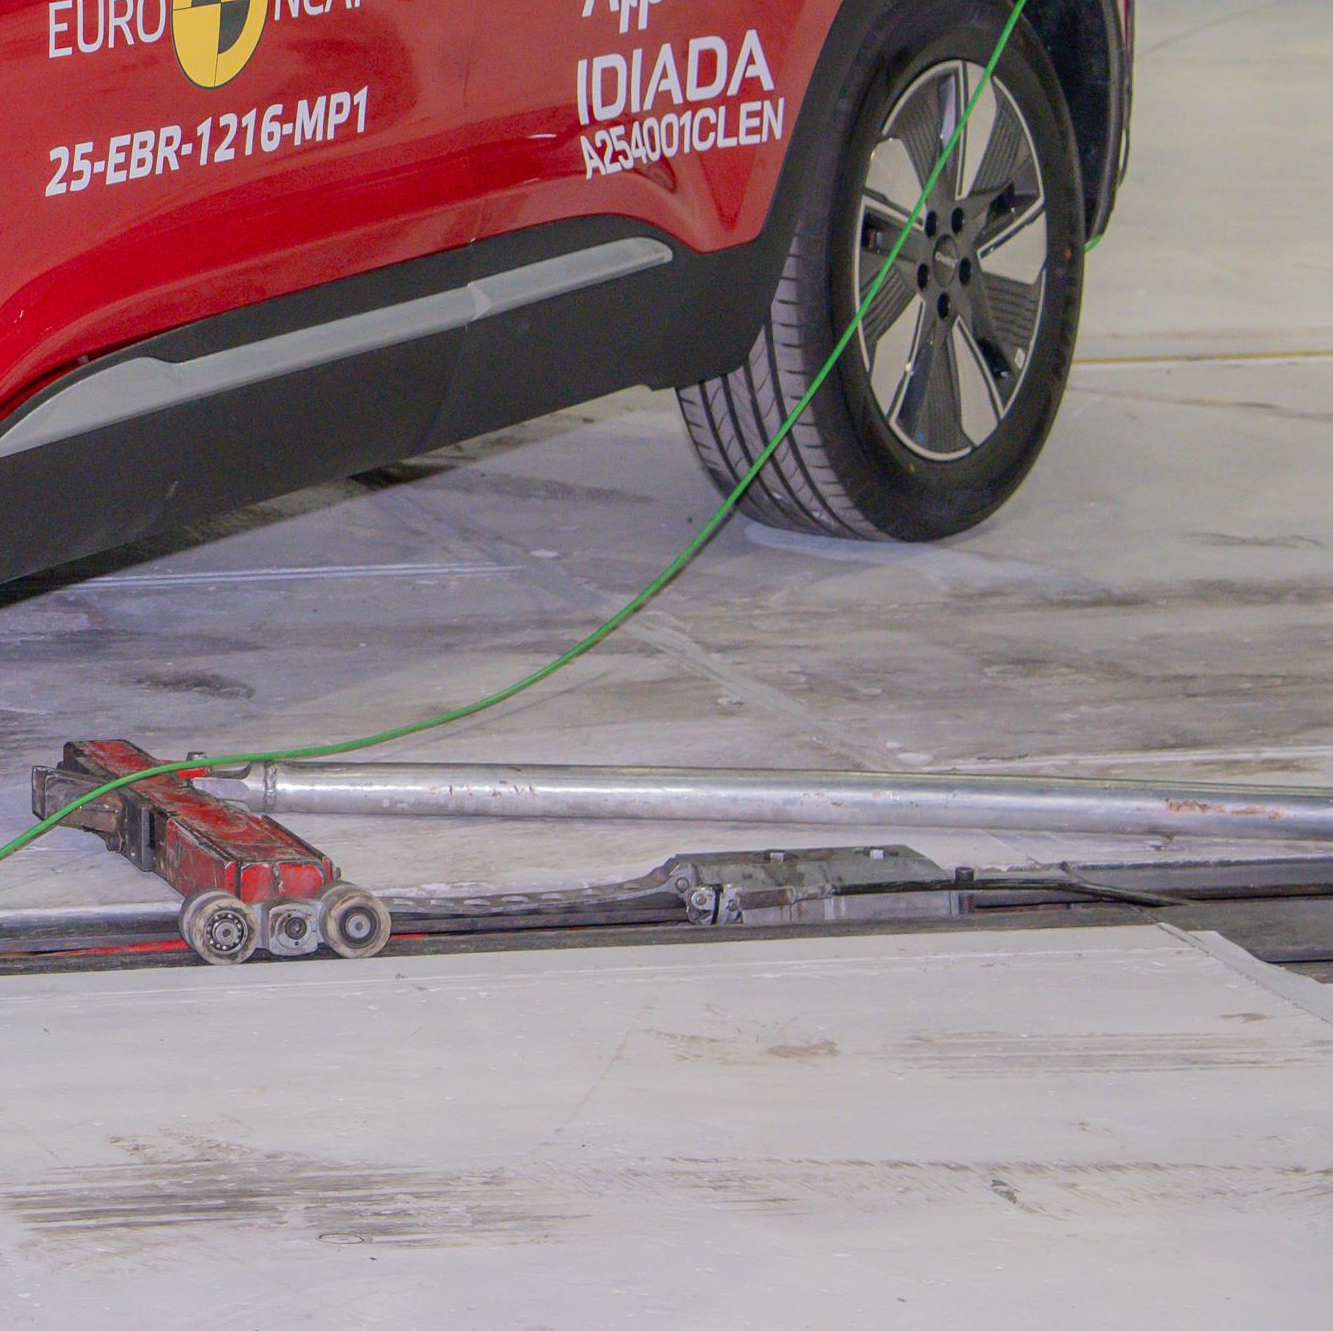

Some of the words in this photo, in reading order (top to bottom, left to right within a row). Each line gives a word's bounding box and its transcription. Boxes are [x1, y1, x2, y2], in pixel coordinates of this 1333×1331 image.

[576, 28, 776, 126] IDIADA
[44, 85, 369, 198] 25-EBR-1216-MP1
[579, 97, 785, 180] A254001CLEN
